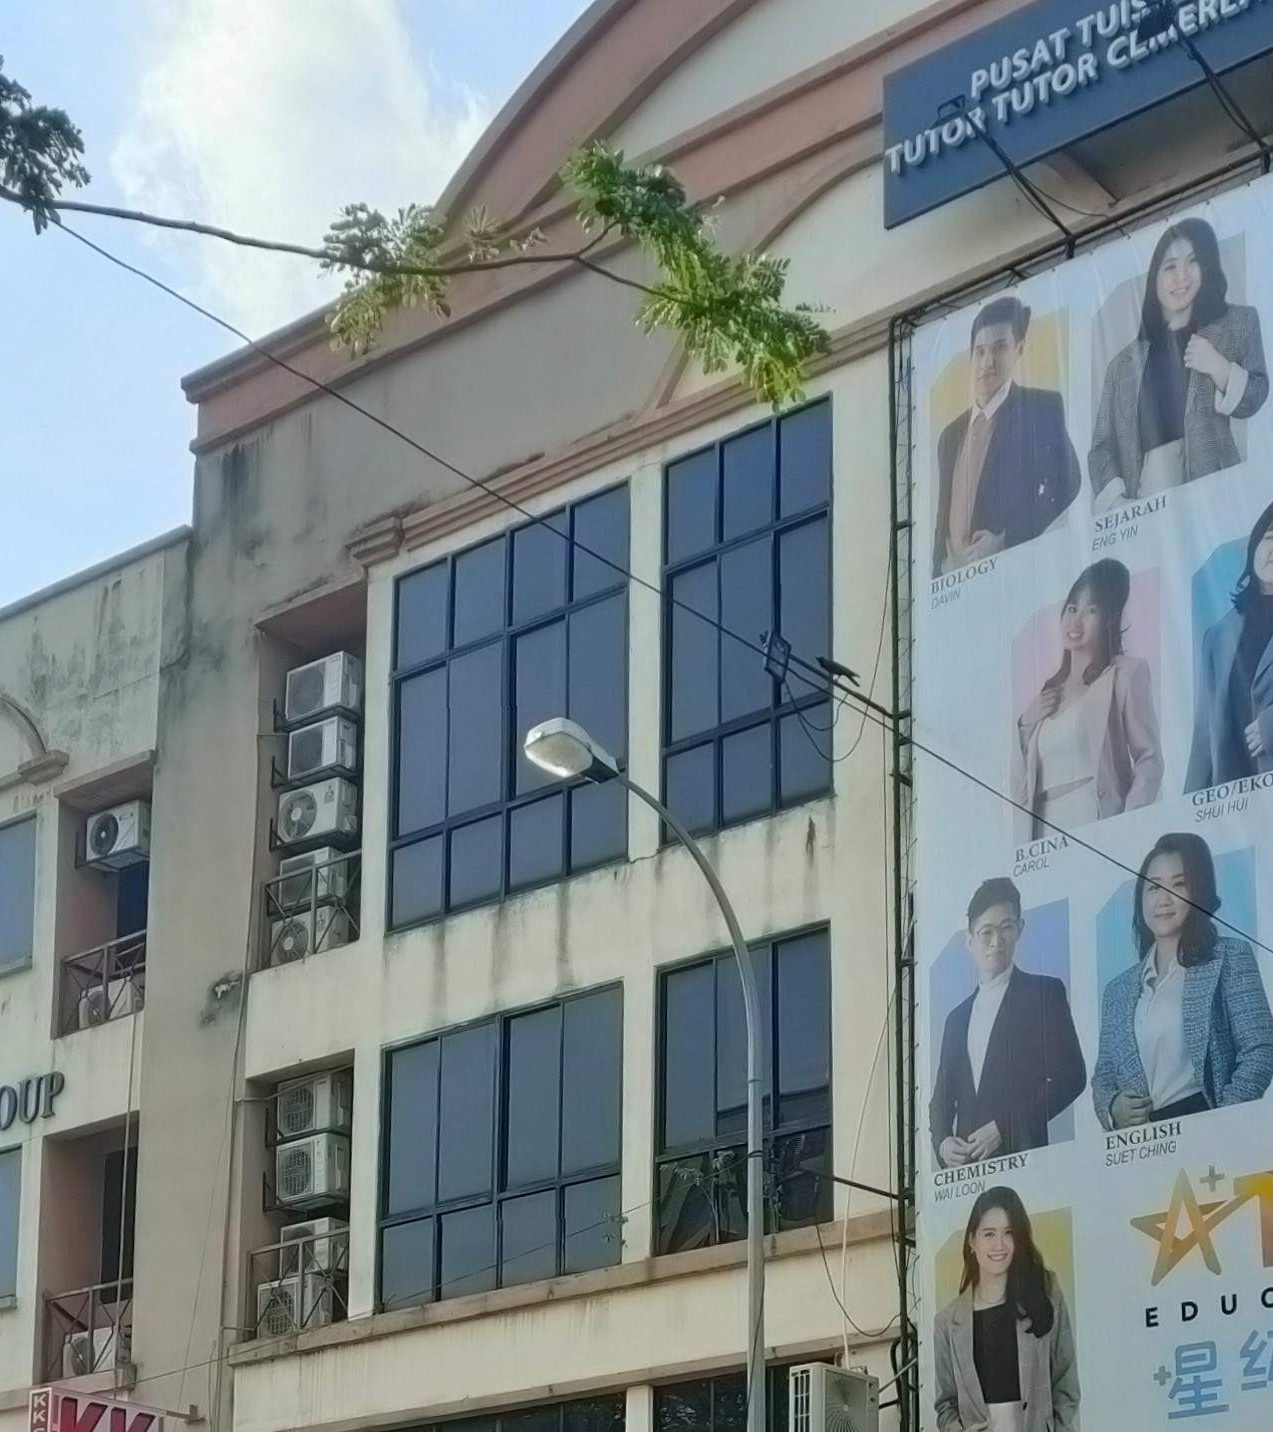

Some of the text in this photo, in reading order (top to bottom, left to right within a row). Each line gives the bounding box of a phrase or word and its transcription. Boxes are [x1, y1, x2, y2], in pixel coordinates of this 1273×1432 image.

[971, 26, 1072, 101] PUSAT
[885, 50, 1099, 176] TUTOR TUTOR
[1094, 495, 1167, 533] SEJARAH
[1092, 525, 1139, 551] ENG YIN
[930, 556, 999, 595] BIOLOGY
[930, 588, 961, 610] DAVIN
[1195, 798, 1249, 823] SHUI HUI
[1014, 835, 1070, 865] B.CINA
[1012, 857, 1050, 878] CAROL
[1105, 1121, 1182, 1150] ENGLISH
[1105, 1140, 1177, 1167] SUET CHING
[933, 1153, 1030, 1187] CHEMISTRY
[954, 1179, 987, 1199] LOON
